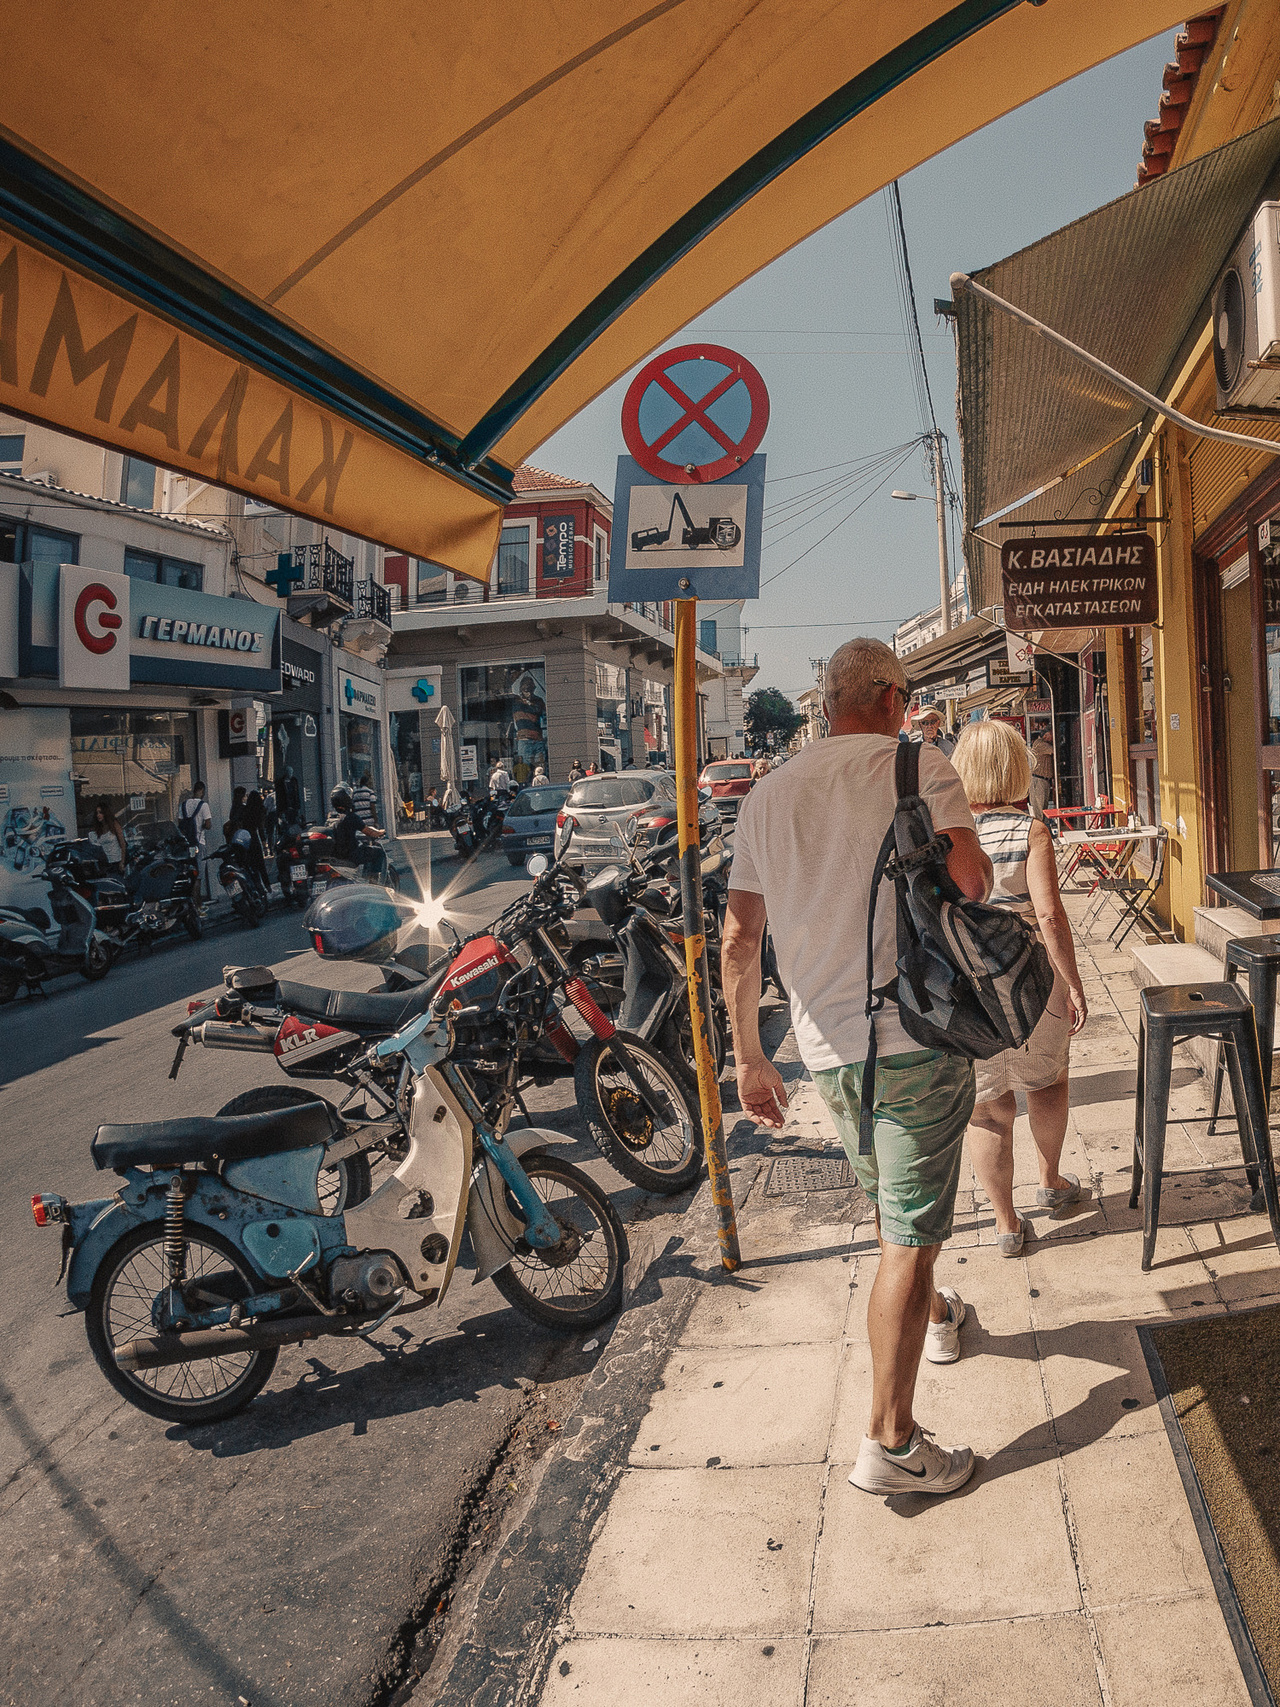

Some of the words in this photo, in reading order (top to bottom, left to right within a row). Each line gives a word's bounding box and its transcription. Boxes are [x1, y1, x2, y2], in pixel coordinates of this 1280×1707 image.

[557, 522, 569, 571] Tempo
[1008, 582, 1044, 597] ΕΙΔΗ
[1049, 577, 1146, 593] ΗΛΕΚΤΡΙΚΩΝ
[1015, 599, 1142, 617] ΕΓΚΑΤΑΣΤΑΣΕΩΝ
[140, 615, 264, 652] ΓΕΡΜΑΝΟΣ
[450, 955, 499, 988] Kawasaki
[280, 1028, 320, 1053] KLR
